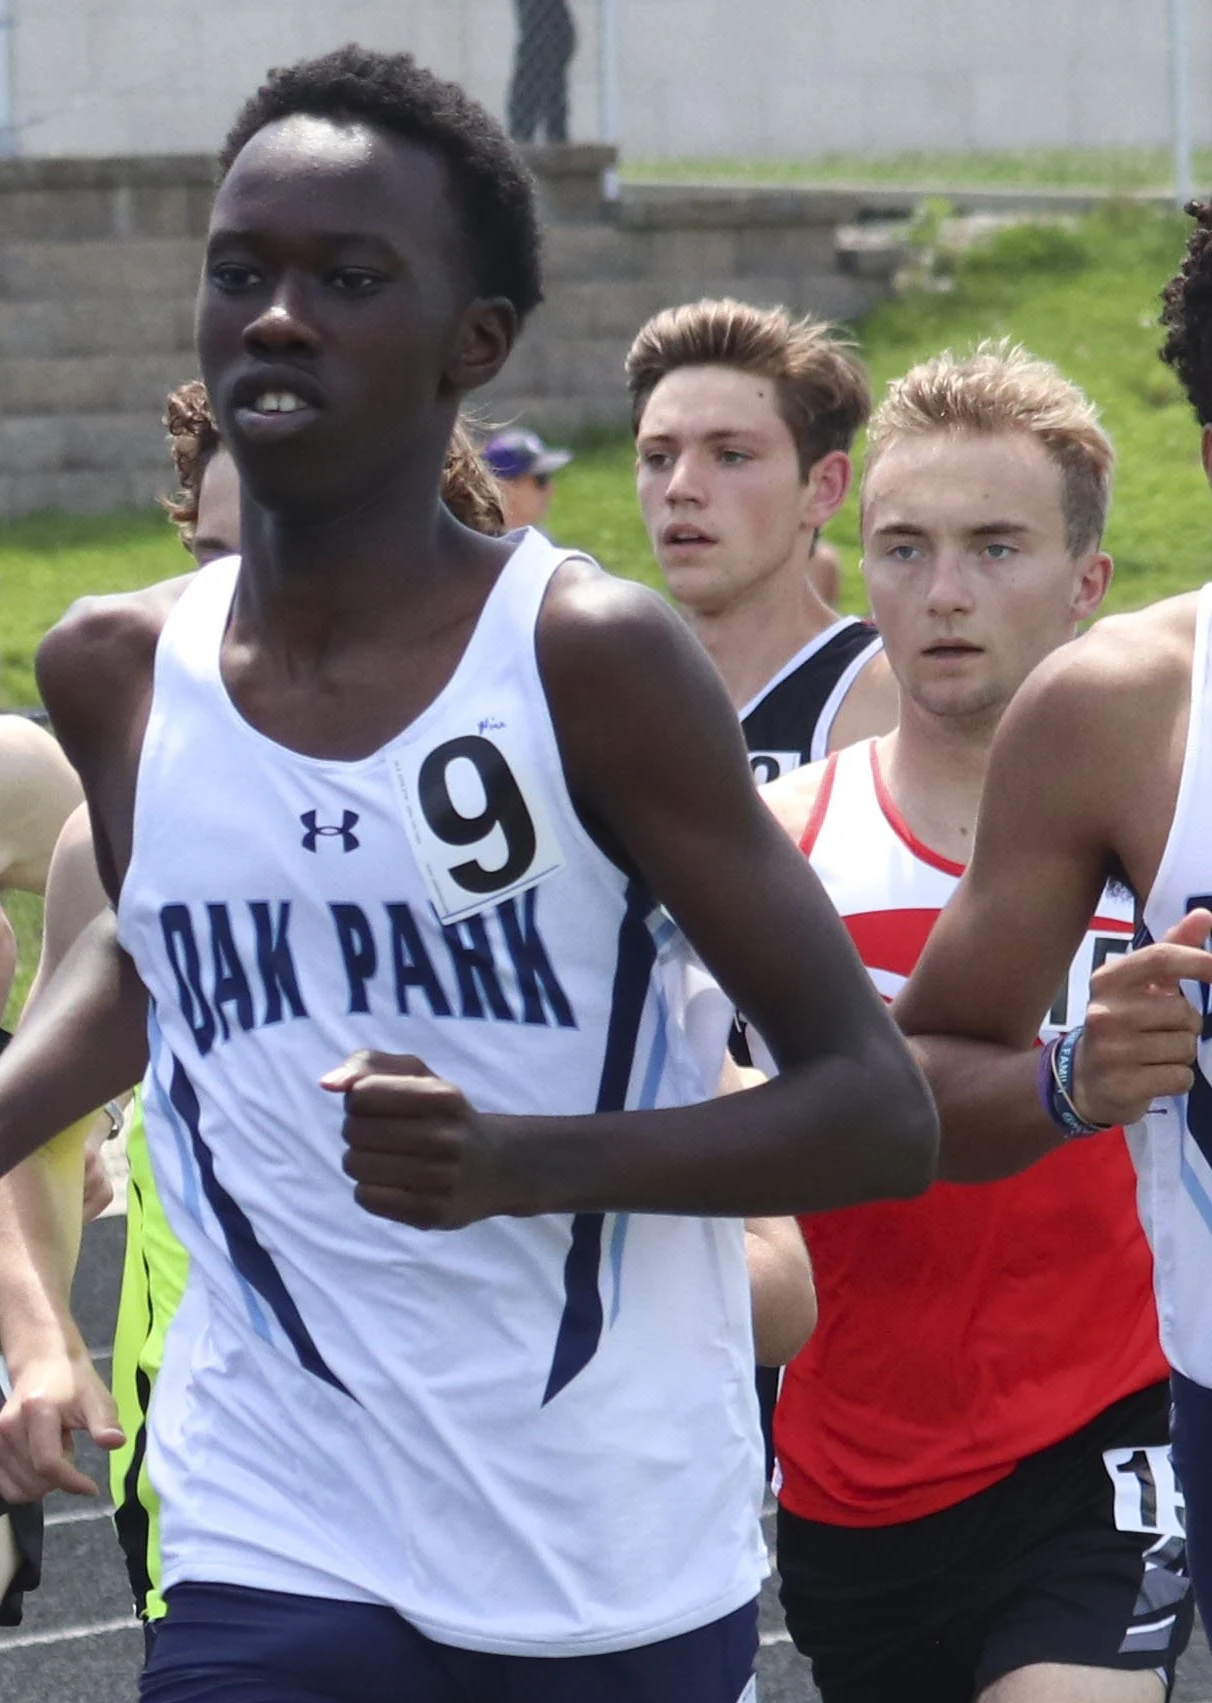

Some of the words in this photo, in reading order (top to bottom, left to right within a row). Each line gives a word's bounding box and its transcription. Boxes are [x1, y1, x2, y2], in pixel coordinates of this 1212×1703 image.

[418, 735, 536, 894] 9
[159, 899, 309, 1057] OAK
[328, 887, 579, 1030] PARK
[1115, 1449, 1186, 1529] 1
